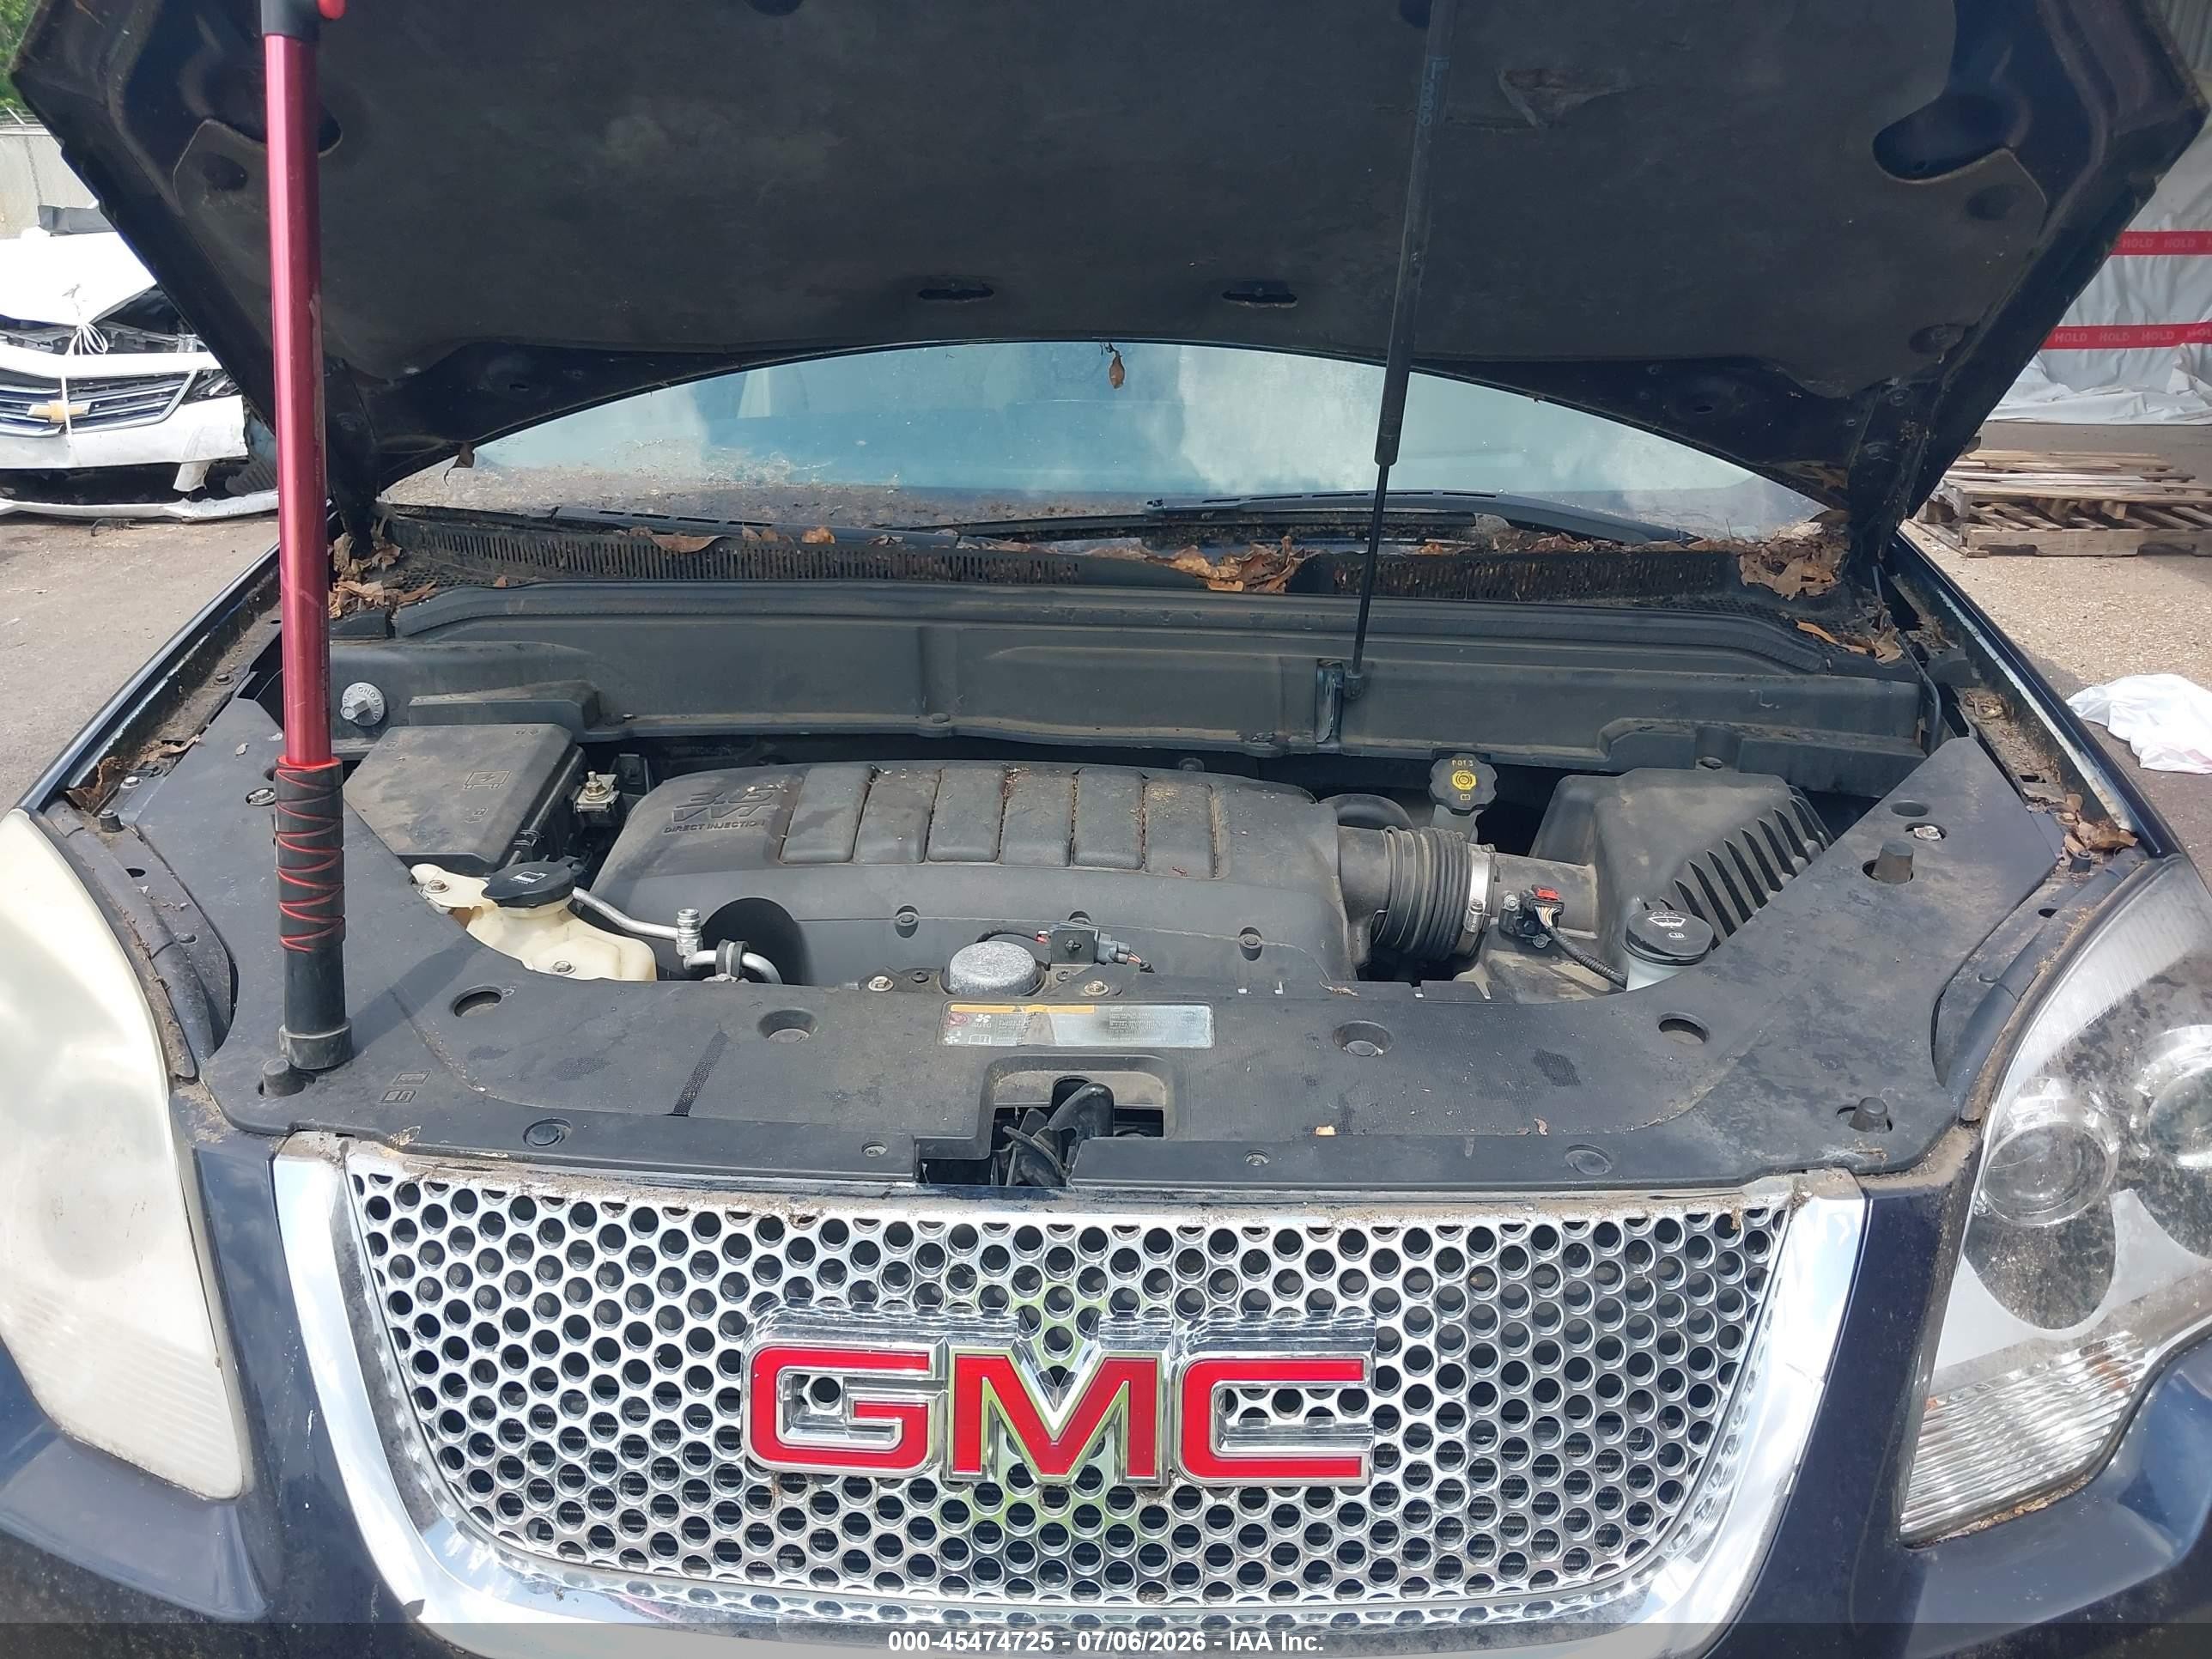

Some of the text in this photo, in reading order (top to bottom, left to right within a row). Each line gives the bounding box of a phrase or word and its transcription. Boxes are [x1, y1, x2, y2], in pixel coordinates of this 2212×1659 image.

[2122, 237, 2154, 248] HOLD
[2164, 237, 2197, 248] HOLD
[2055, 332, 2087, 343] HOLD
[2099, 332, 2130, 343] HOLD
[2142, 330, 2175, 341] HOLD
[664, 823, 705, 833] DIRECT
[741, 1338, 1373, 1487] GMC
